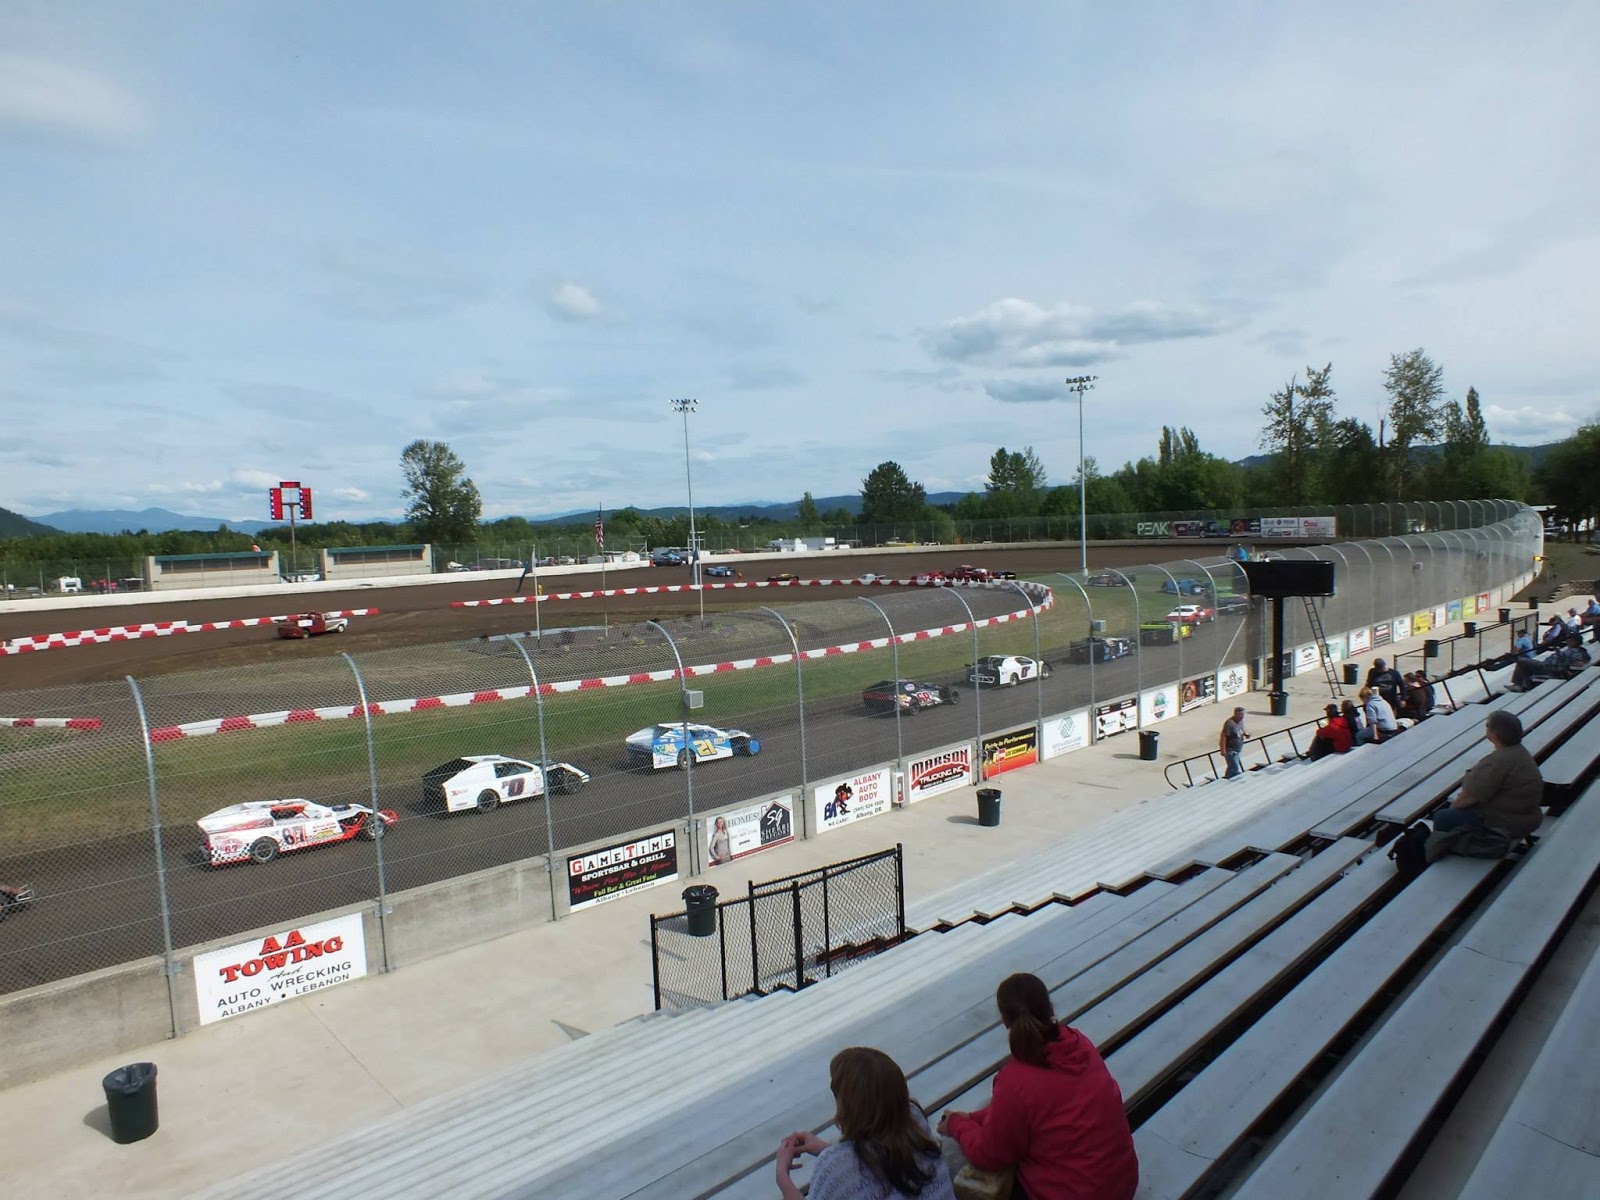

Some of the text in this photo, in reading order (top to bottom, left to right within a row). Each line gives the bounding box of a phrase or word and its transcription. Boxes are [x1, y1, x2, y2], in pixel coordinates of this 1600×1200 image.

[1137, 521, 1169, 535] PEAK
[693, 738, 718, 757] 21
[911, 749, 968, 782] MARSON
[853, 772, 882, 786] ALBANY
[858, 782, 878, 794] AUTO
[858, 791, 878, 802] BODY
[581, 853, 666, 882] SPORTSBAR & GRILL
[593, 873, 657, 898] Full Bar & Great Food
[595, 881, 655, 904] Albany Lebanon
[219, 936, 344, 984] TOWING
[217, 961, 352, 1008] AUTO WRECKING
[221, 973, 351, 1018] ALBANY LEBANON
